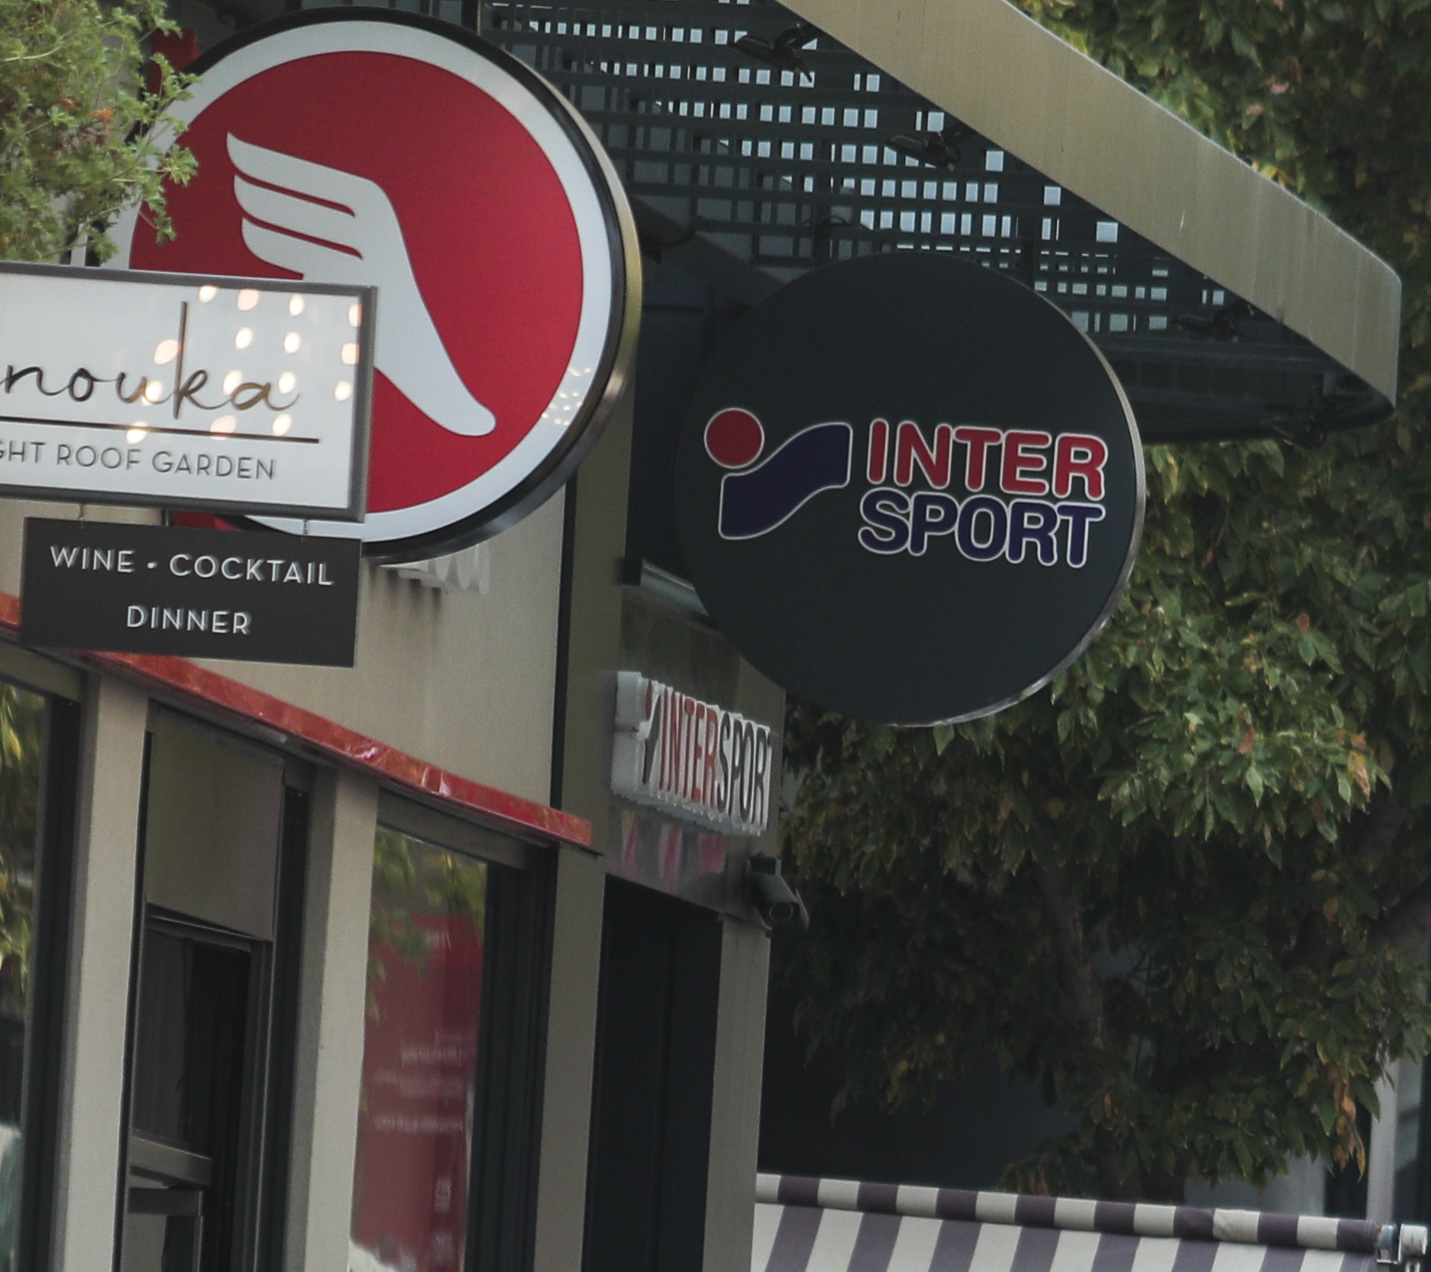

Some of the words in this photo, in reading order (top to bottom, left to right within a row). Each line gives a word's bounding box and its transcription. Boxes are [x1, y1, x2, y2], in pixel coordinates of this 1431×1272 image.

[57, 446, 141, 471] ROOF
[152, 450, 277, 479] GARDEN
[867, 418, 1108, 500] INTER
[858, 488, 1106, 568] SPORT
[50, 545, 135, 574] WINE
[169, 553, 336, 588] COCKTAIL
[126, 604, 253, 635] DINNER
